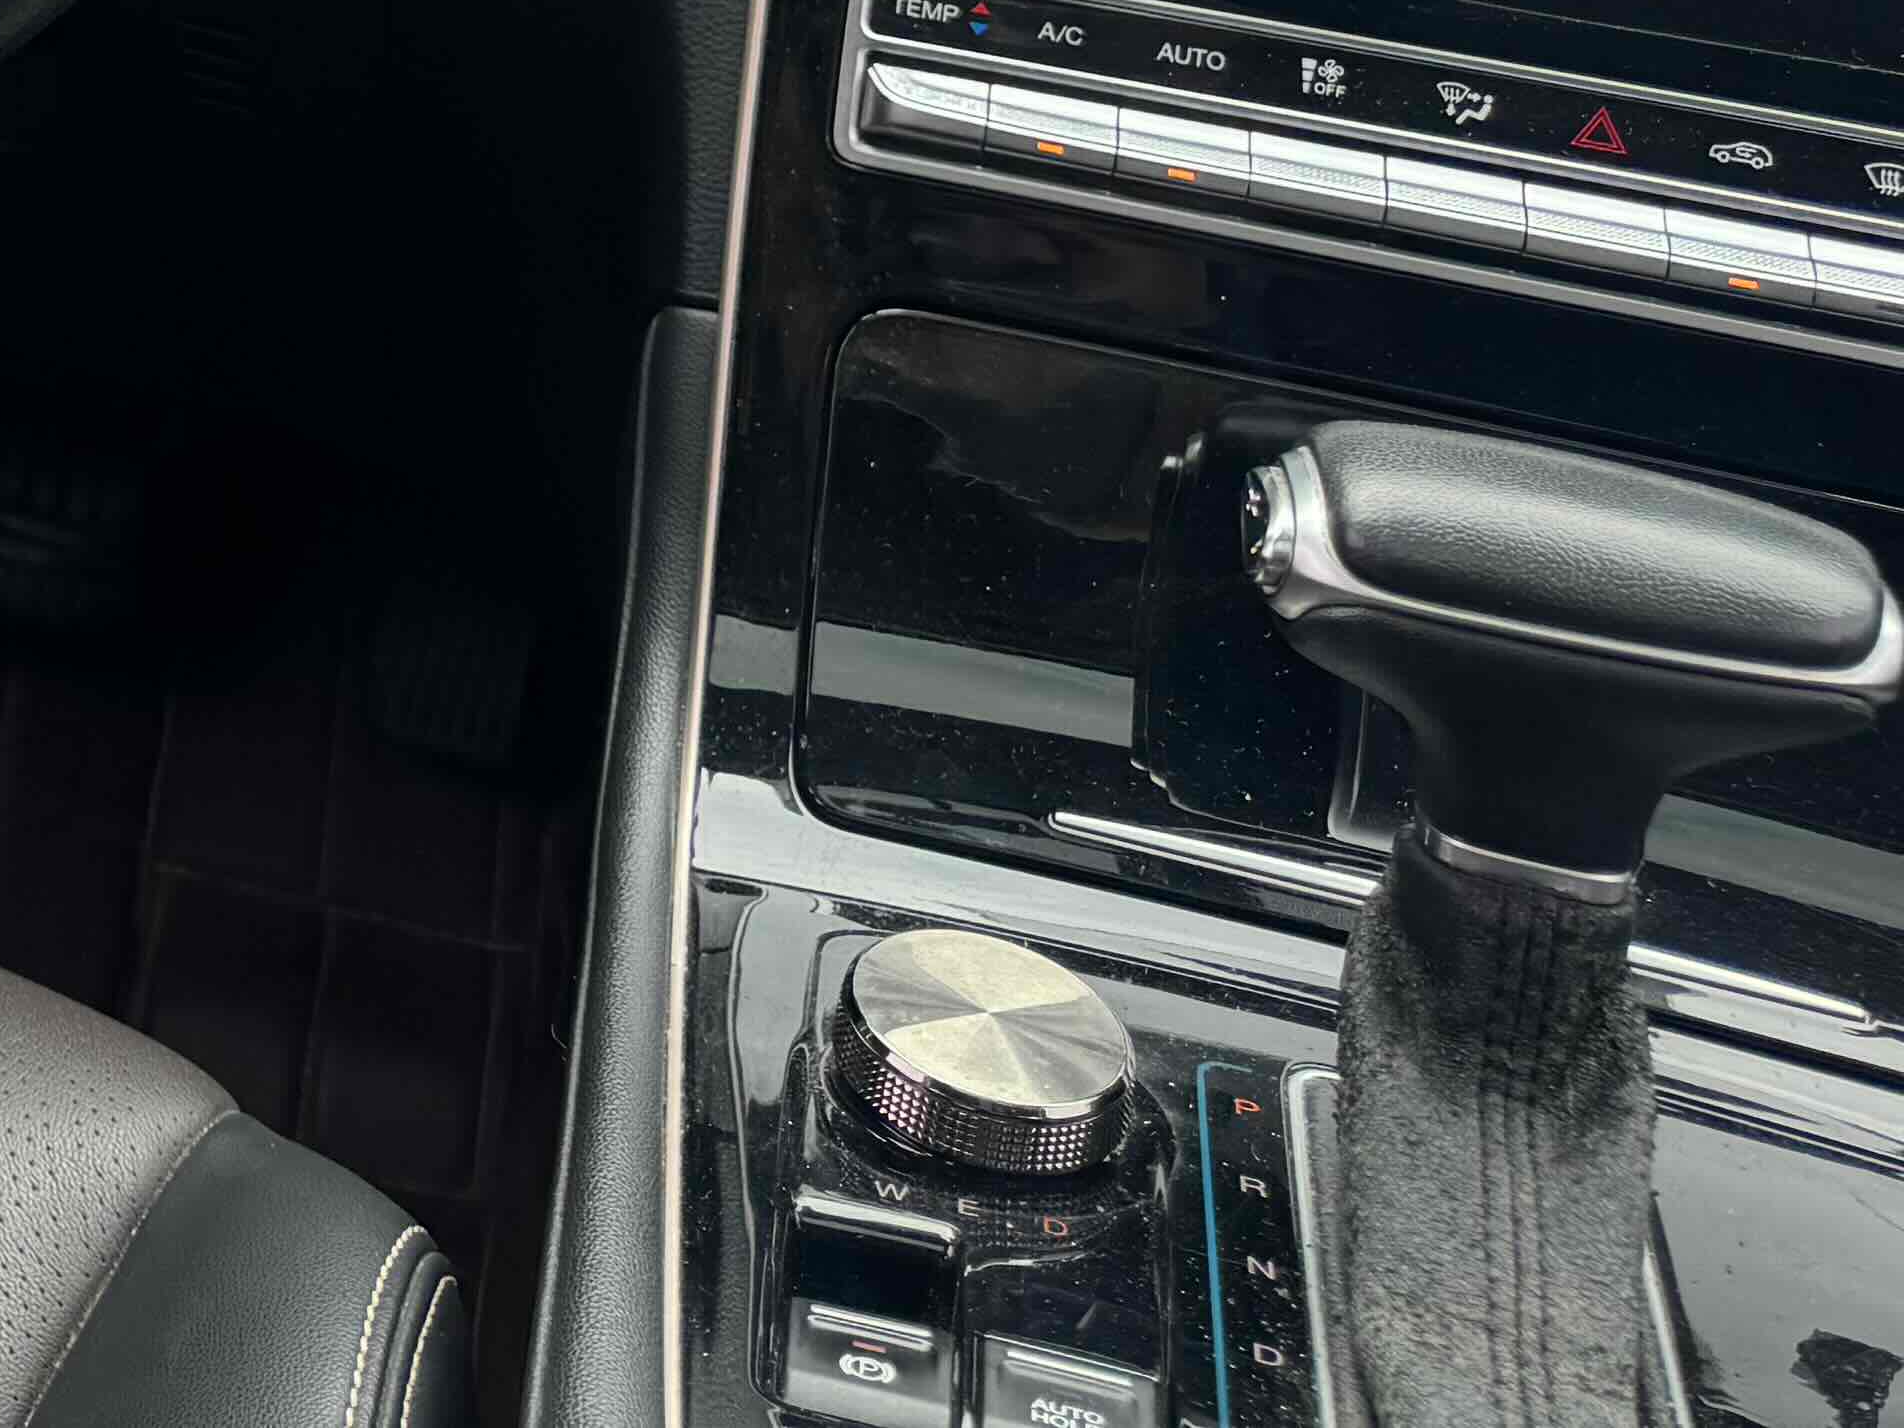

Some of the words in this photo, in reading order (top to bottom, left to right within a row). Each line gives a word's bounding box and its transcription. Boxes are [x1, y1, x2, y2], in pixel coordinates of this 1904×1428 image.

[1037, 22, 1087, 47] A/C
[1156, 42, 1227, 71] AUTO
[1314, 81, 1346, 99] OFF
[1233, 1097, 1261, 1116] P
[1239, 1175, 1268, 1199] R
[874, 1179, 910, 1202] W
[958, 1197, 980, 1218] E
[1043, 1215, 1070, 1236] D
[1246, 1255, 1278, 1281] N
[1254, 1343, 1285, 1366] D
[1030, 1397, 1105, 1425] AUTO
